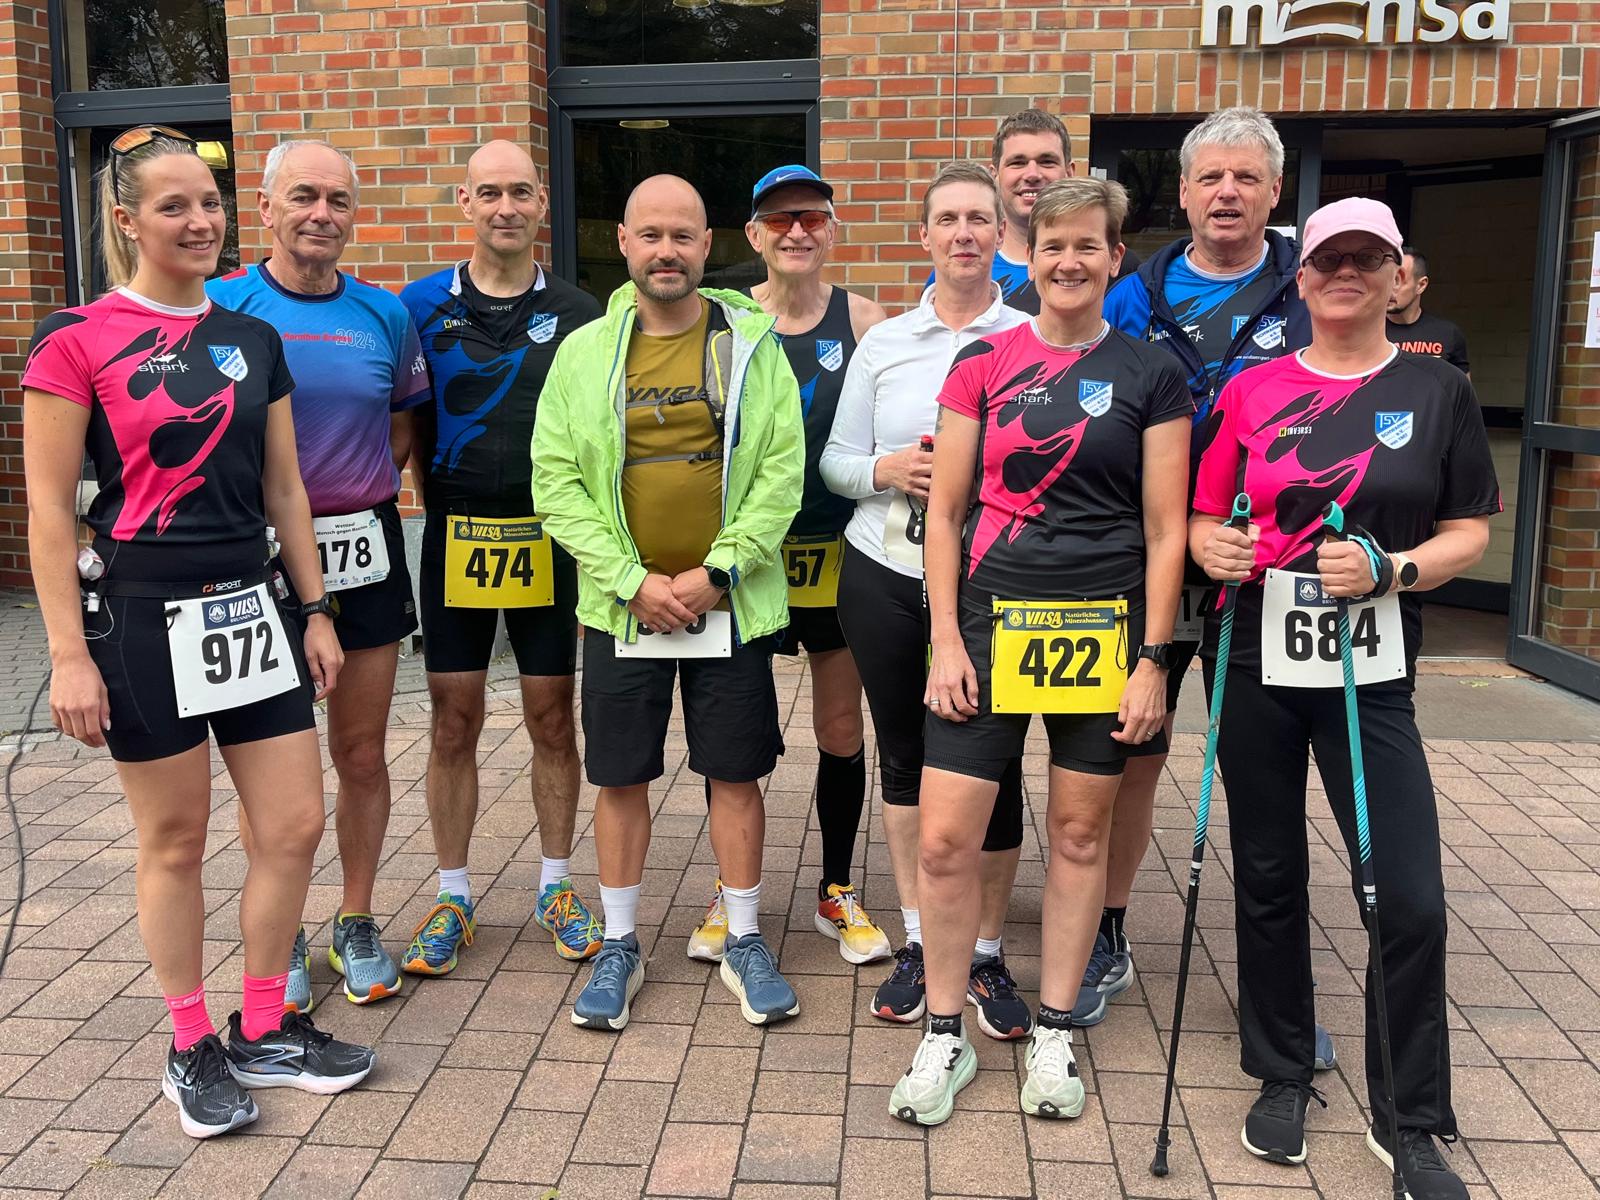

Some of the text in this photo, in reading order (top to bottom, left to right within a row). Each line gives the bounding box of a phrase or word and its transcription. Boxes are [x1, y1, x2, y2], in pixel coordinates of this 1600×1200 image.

[335, 328, 376, 350] 2024
[817, 340, 835, 355] TSV
[210, 346, 233, 362] TSV
[137, 360, 190, 374] shark
[1081, 381, 1102, 396] TSV
[1009, 392, 1053, 405] shark
[1377, 413, 1401, 428] TSV
[471, 525, 502, 540] VILSA
[317, 536, 372, 574] 178
[465, 547, 534, 588] 474
[781, 548, 826, 588] 57
[228, 596, 260, 618] VILSA
[1025, 611, 1063, 628] VILSA
[1284, 606, 1381, 662] 684
[201, 621, 279, 684] 972
[1019, 637, 1101, 687] 422
